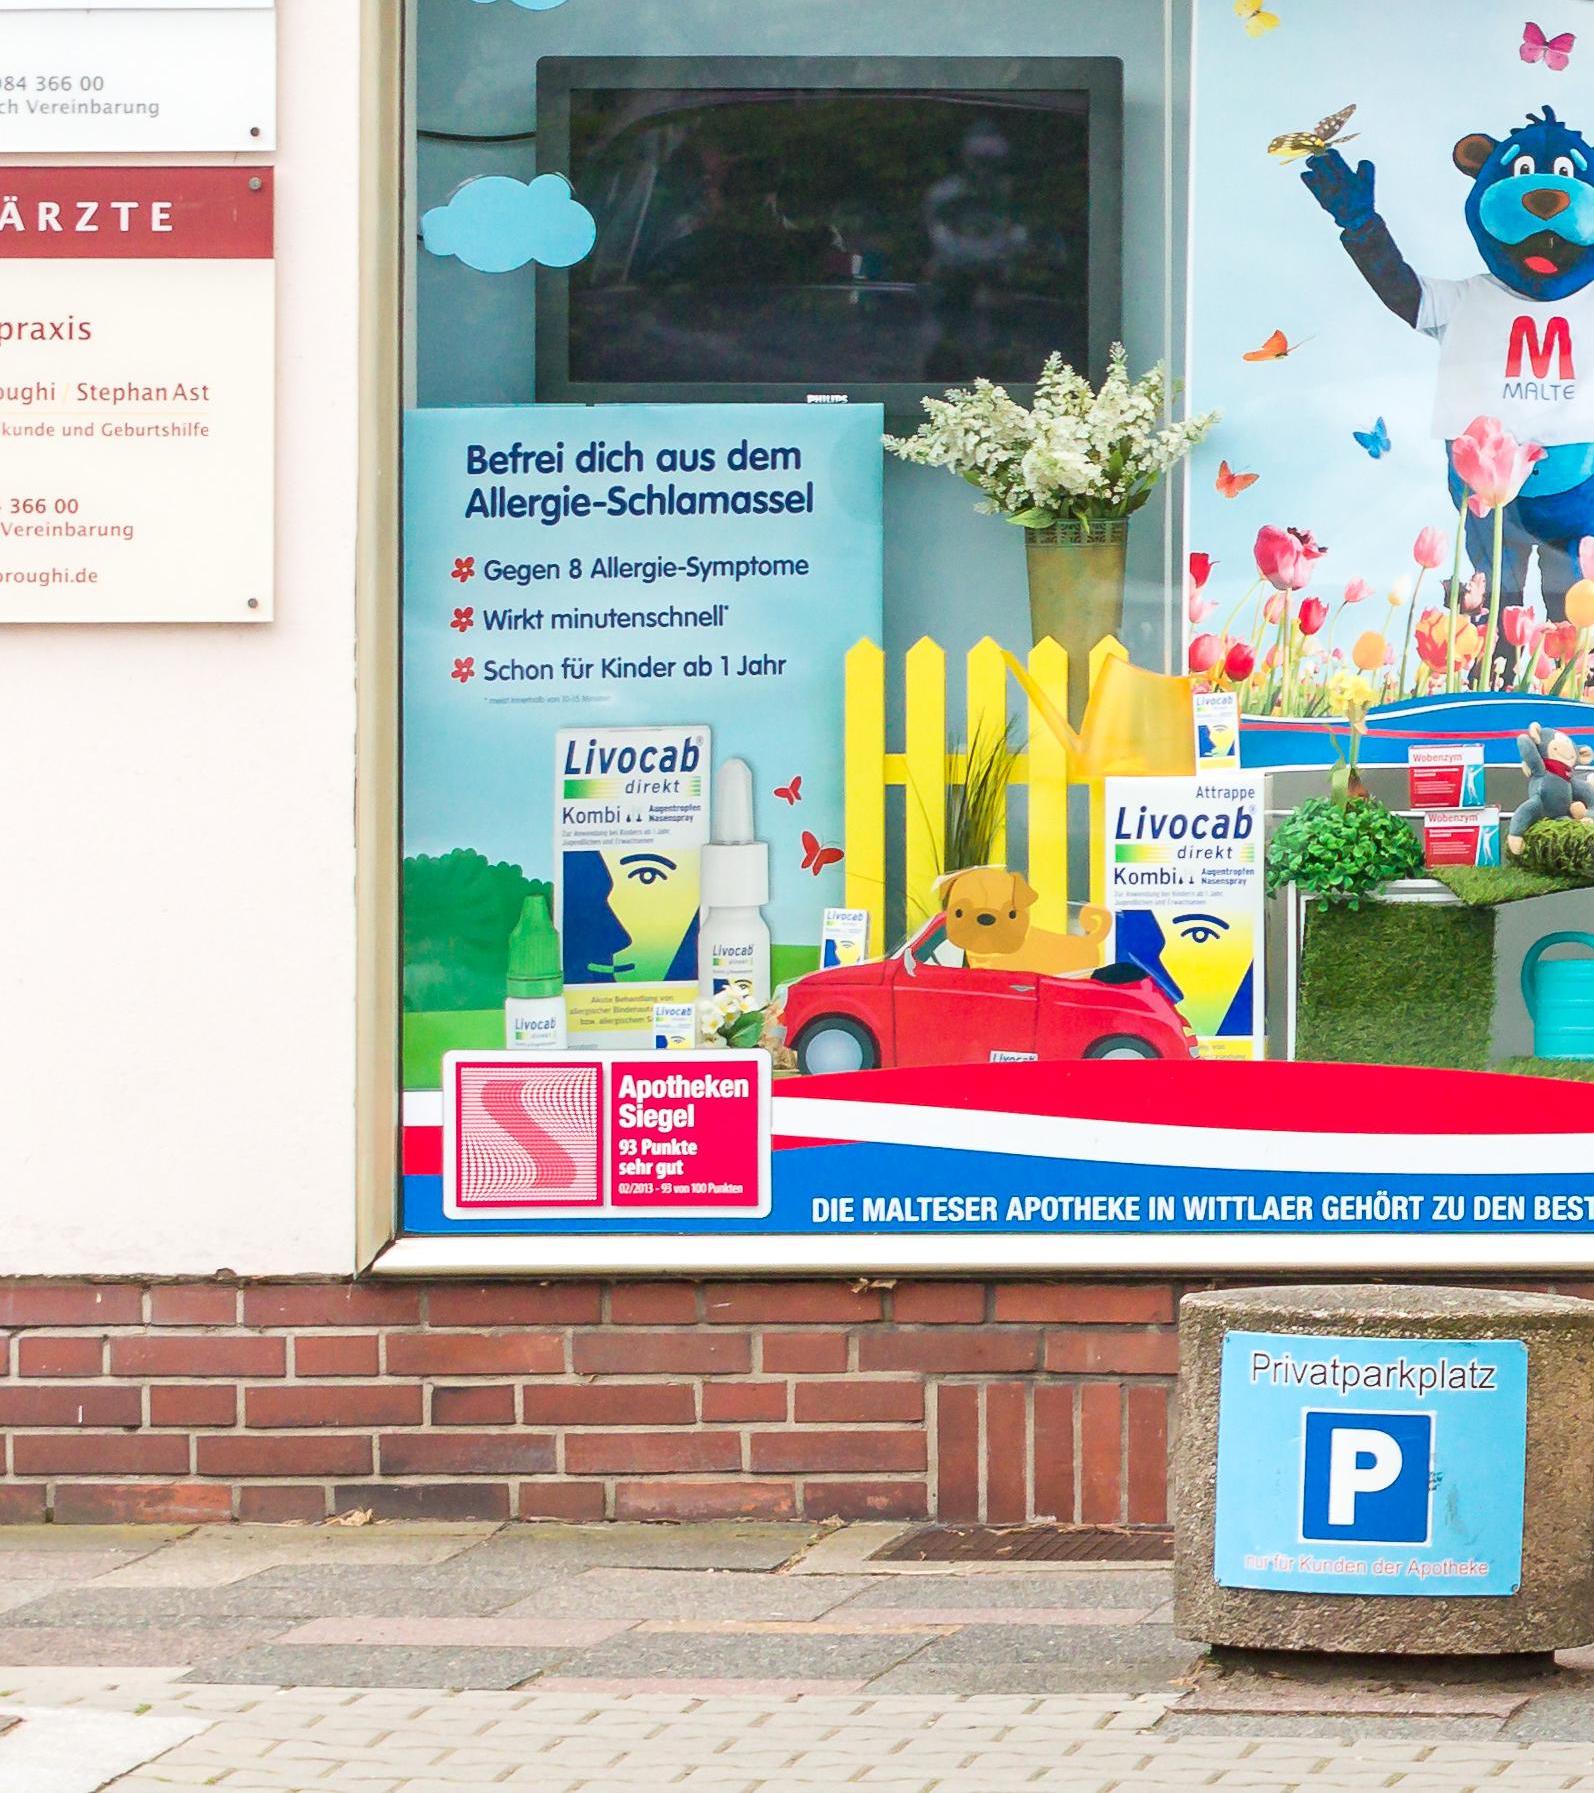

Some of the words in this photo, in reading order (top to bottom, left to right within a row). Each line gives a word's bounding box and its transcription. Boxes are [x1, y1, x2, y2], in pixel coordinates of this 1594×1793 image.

[36, 76, 73, 92] 366
[80, 76, 104, 92] 00
[26, 99, 160, 118] Vereinbarung
[1504, 315, 1576, 381] M
[77, 382, 168, 405] Stephan
[173, 384, 210, 402] Ast
[807, 393, 848, 404] PHILIPS
[1502, 383, 1576, 401] MALTE
[62, 422, 94, 437] und
[101, 420, 209, 437] Geburtshilfe
[466, 441, 564, 475] Befrei
[575, 440, 644, 473] dich
[656, 448, 716, 472] aus
[727, 438, 801, 471] dem
[10, 498, 47, 514] 366
[54, 498, 79, 514] 00
[465, 481, 814, 526] Allergie-Schlamassel
[0, 521, 134, 540] Vereinbarung
[484, 560, 560, 586] Gegen
[568, 558, 582, 579] 8
[591, 556, 810, 584] Allergie-Symptome
[483, 608, 544, 631] Wirkt
[484, 658, 553, 681] Schon
[562, 657, 594, 679] für
[601, 655, 677, 679] Kinder
[683, 654, 713, 676] ab
[720, 656, 730, 675] 1
[736, 653, 788, 676] Jahr
[1413, 752, 1463, 764] Wobenzym
[625, 778, 680, 795] direkt
[1196, 785, 1256, 801] Attrappe
[562, 806, 621, 825] Kombi
[1428, 812, 1478, 824] Wobenzym
[1177, 845, 1233, 859] direkt
[1114, 867, 1177, 885] Kombi
[618, 1074, 750, 1103] Apotheken
[618, 1102, 696, 1132] Siegel
[618, 1138, 638, 1156] 93
[641, 1138, 699, 1157] Punkte
[618, 1159, 654, 1175] sehr
[656, 1159, 684, 1178] gut
[618, 1182, 654, 1195] 02/2013
[708, 1182, 744, 1195] Punkten
[811, 1196, 855, 1223] DIE
[862, 1196, 998, 1223] MALTESER
[1006, 1196, 1140, 1223] APOTHEKE
[1148, 1196, 1174, 1223] IN
[1182, 1196, 1313, 1223] WITTLAER
[1321, 1190, 1422, 1222] GEHÖRT
[1432, 1195, 1465, 1222] ZU
[1473, 1195, 1518, 1222] DEN
[1252, 1351, 1497, 1397] Privatparkplatz
[1327, 1426, 1404, 1526] P
[1272, 1553, 1297, 1572] für
[1299, 1555, 1368, 1575] Kunden
[1371, 1557, 1402, 1576] der
[1406, 1559, 1490, 1580] Apotheke
